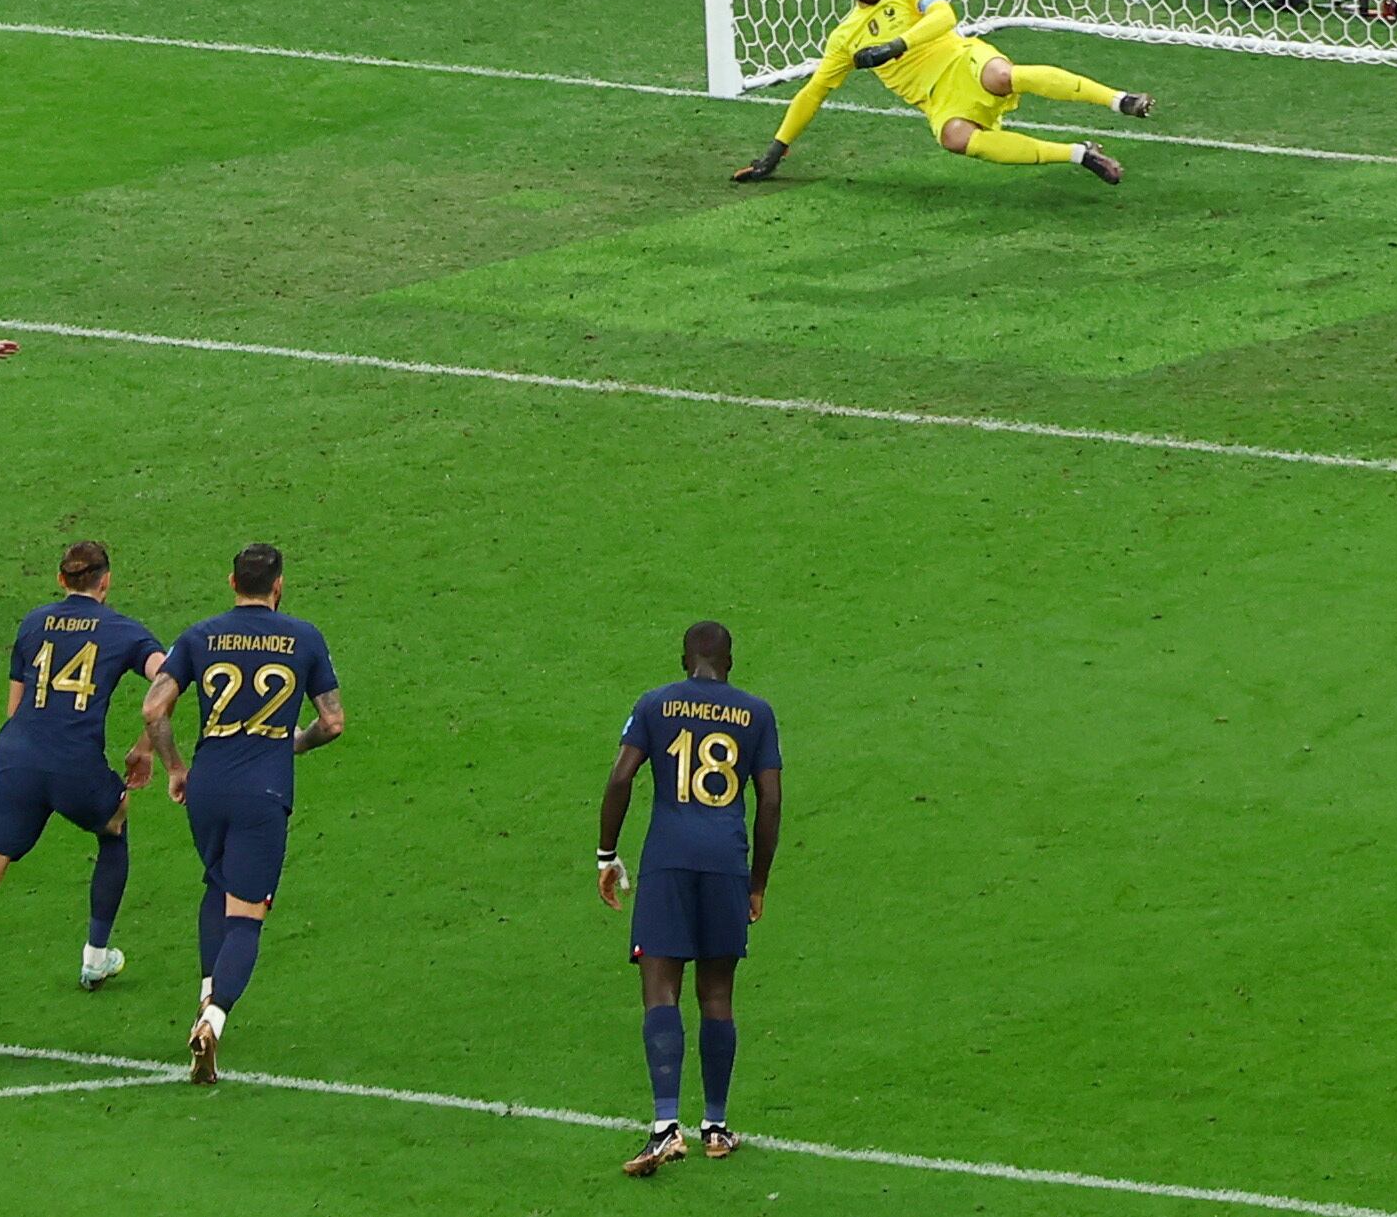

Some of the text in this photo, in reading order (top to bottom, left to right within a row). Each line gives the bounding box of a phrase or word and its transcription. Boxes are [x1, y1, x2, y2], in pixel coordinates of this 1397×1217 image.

[44, 615, 100, 633] RABIOT
[206, 634, 296, 655] T.HERNANDEZ
[31, 639, 99, 712] 14
[202, 661, 297, 740] 22
[662, 700, 751, 728] UPAMECANO
[666, 728, 740, 808] 18
